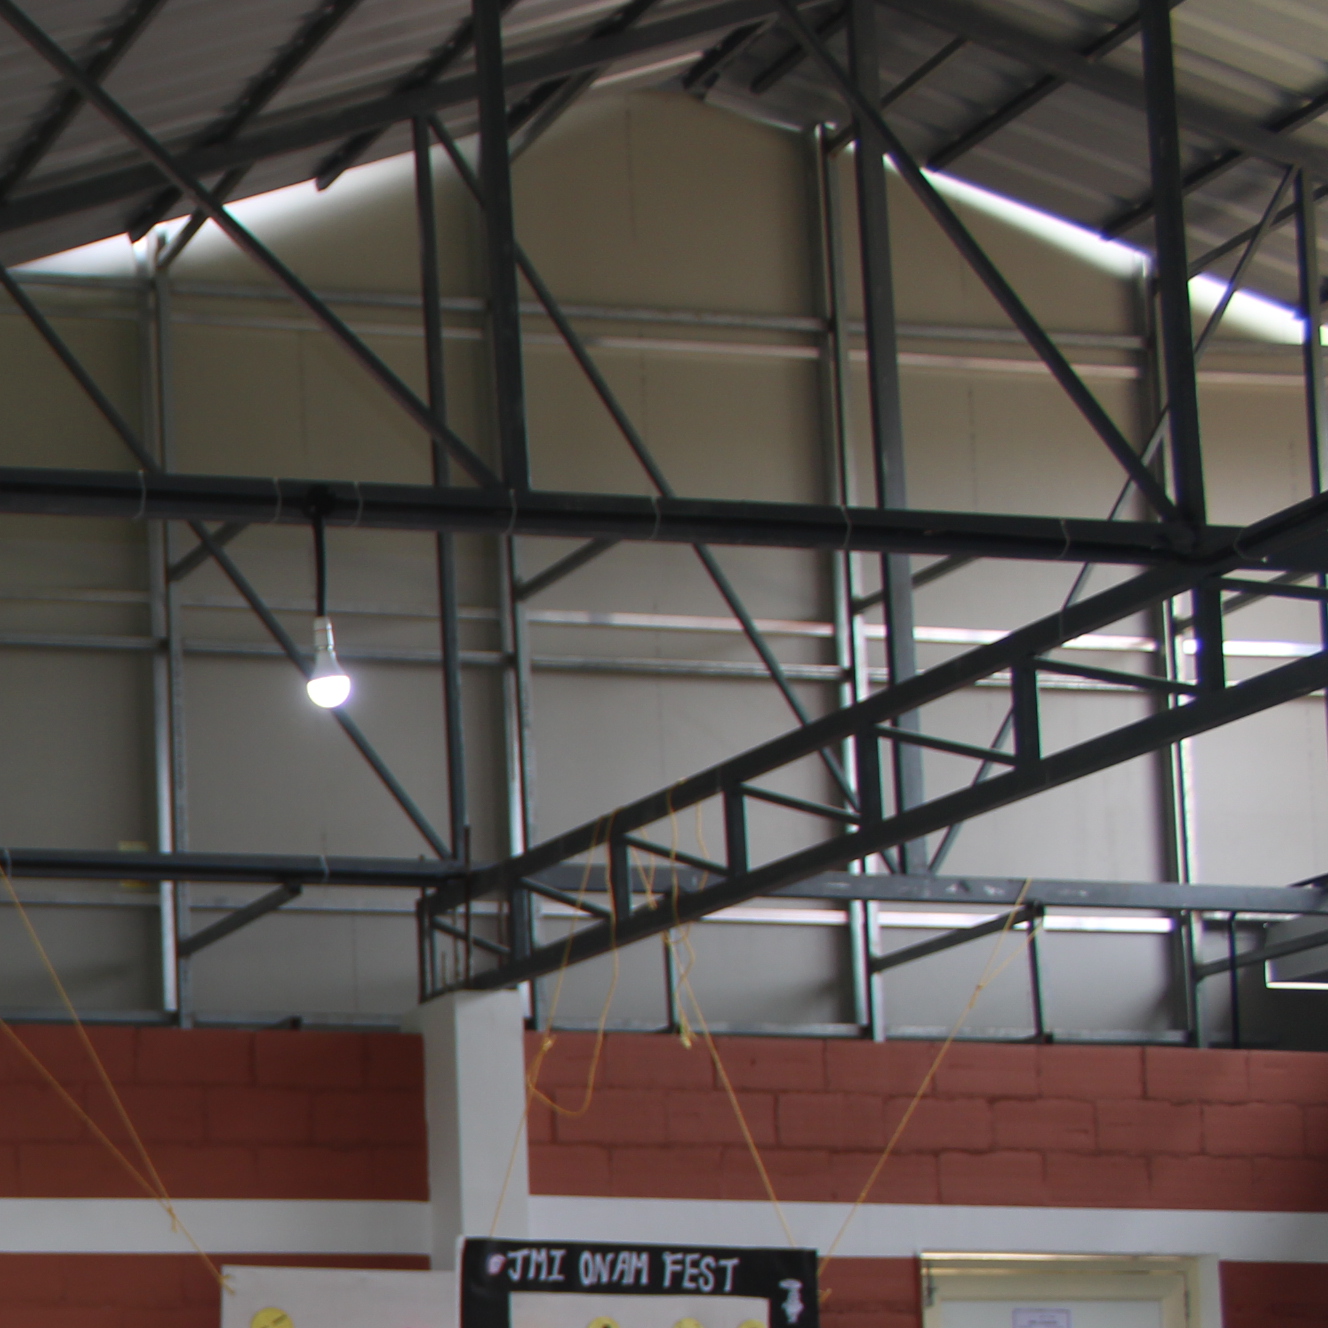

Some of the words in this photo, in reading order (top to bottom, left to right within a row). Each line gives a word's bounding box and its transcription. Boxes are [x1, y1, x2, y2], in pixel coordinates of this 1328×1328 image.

[507, 1248, 567, 1282] JMI
[578, 1250, 650, 1287] ONAM
[662, 1251, 740, 1293] FEST
